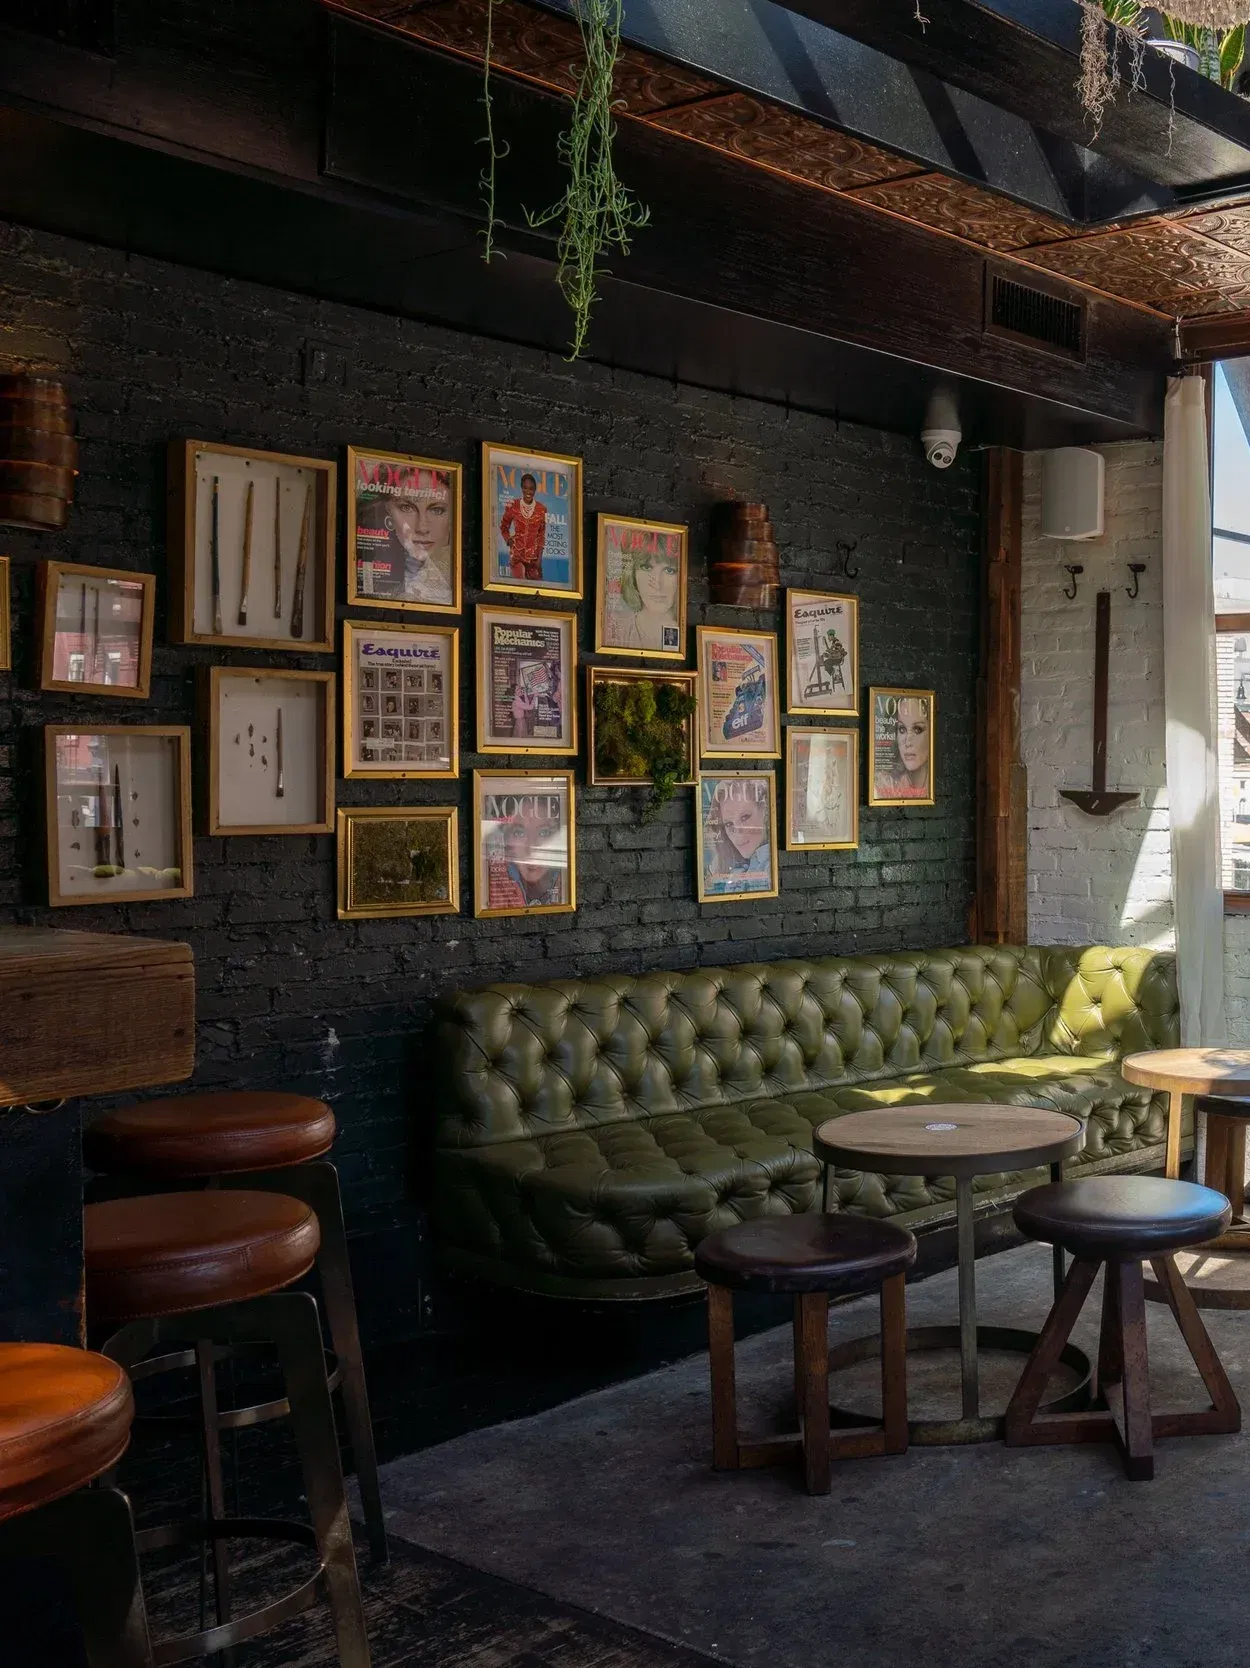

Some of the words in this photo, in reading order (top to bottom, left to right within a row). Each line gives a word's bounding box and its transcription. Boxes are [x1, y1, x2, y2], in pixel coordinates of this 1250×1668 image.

[357, 480, 402, 498] looking
[405, 486, 447, 500] terrific!
[544, 512, 567, 525] FALL
[357, 526, 389, 538] beauty
[547, 532, 563, 540] MOST
[794, 606, 843, 618] Esquire
[494, 626, 533, 641] Popular
[494, 635, 545, 648] Mechanics
[361, 643, 440, 659] Esquire
[731, 713, 749, 730] elf
[486, 795, 560, 820] VOGUE
